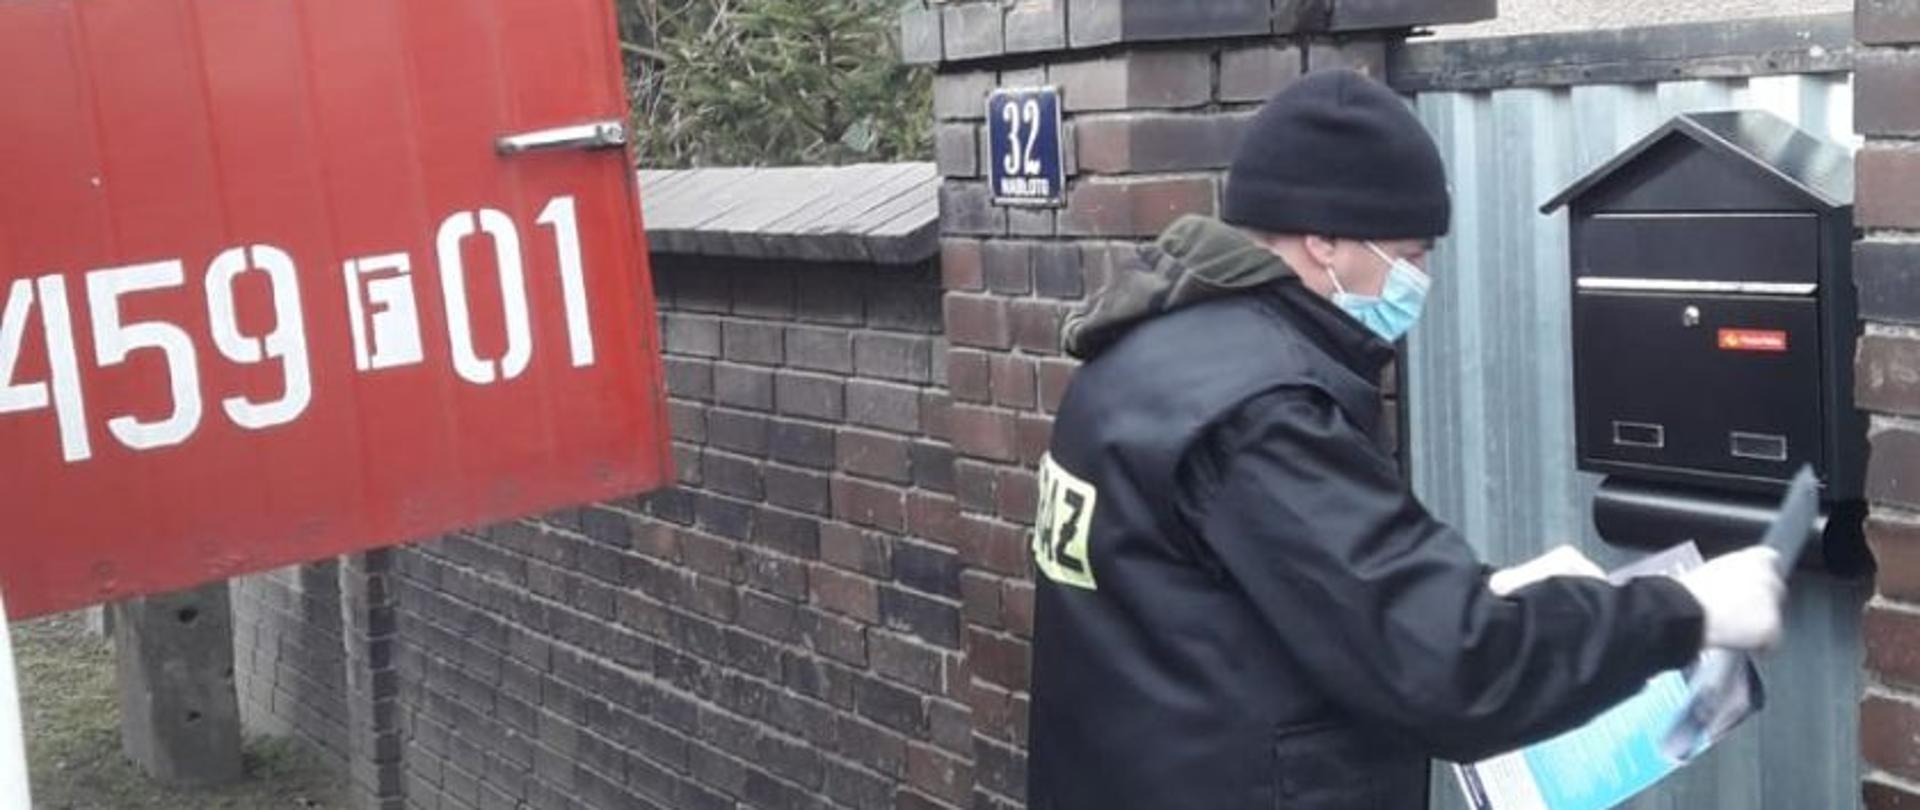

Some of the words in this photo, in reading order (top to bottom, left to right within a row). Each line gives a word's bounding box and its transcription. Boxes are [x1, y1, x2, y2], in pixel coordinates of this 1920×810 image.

[1003, 99, 1041, 175] 32
[0, 244, 312, 463] 459
[435, 195, 596, 385] 01
